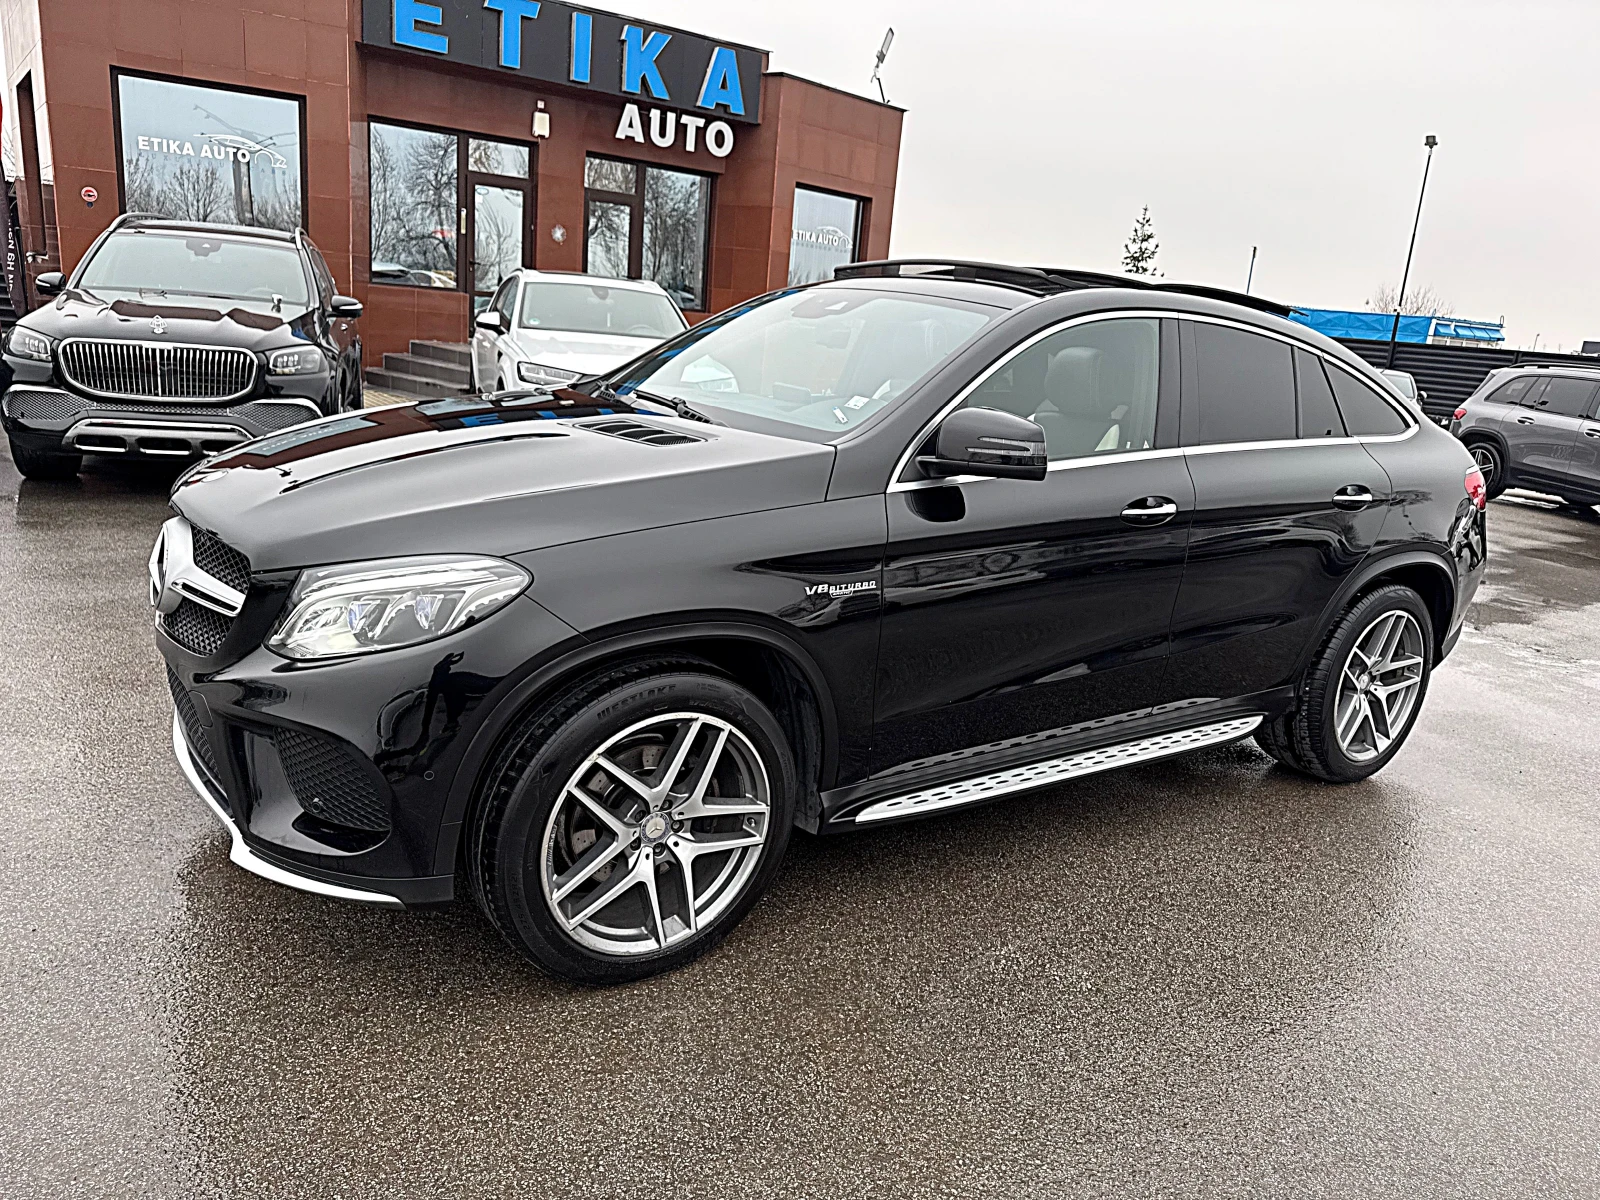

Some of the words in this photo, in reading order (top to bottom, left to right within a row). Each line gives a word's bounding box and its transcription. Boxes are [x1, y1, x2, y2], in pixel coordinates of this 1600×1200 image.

[391, 0, 745, 116] ETIKA
[137, 135, 195, 157] ETIKA
[200, 144, 251, 163] AUTO
[615, 102, 735, 158] AUTO
[793, 229, 816, 243] ETIKA
[818, 233, 839, 247] AUTO
